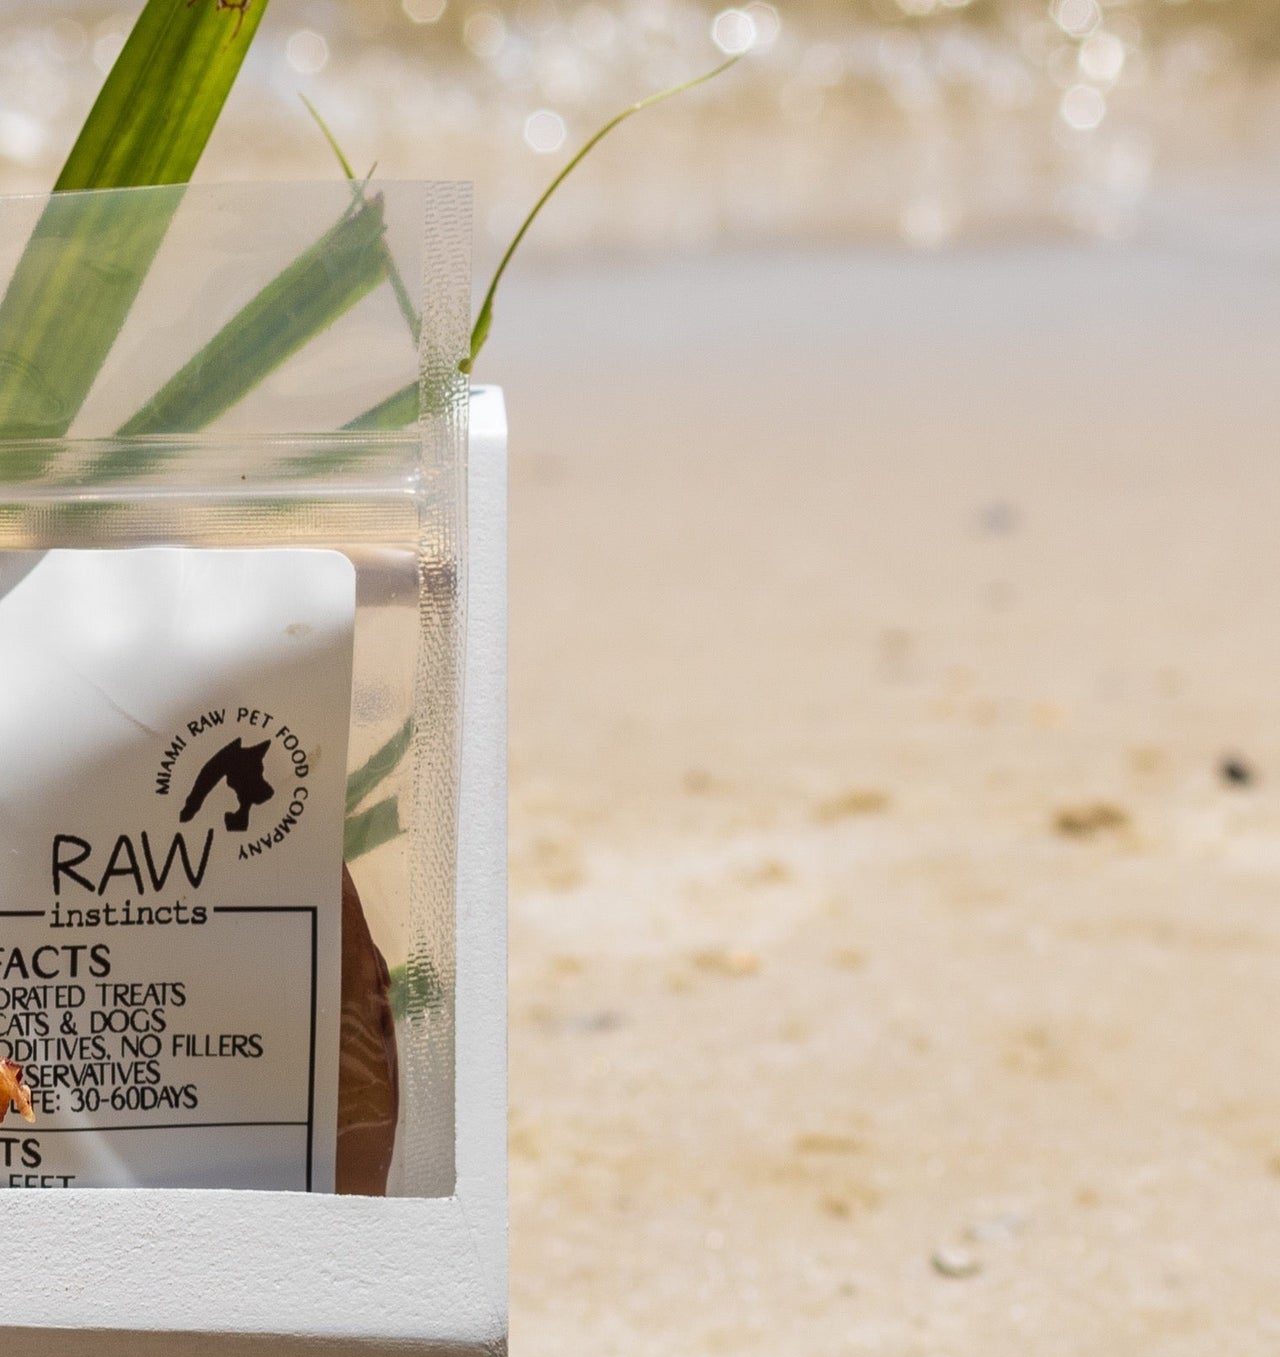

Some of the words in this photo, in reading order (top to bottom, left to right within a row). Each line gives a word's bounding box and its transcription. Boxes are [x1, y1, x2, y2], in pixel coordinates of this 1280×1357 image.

[187, 709, 225, 737] RAW
[237, 707, 274, 729] PET
[156, 735, 187, 795] MIAMI
[275, 726, 309, 778] FOOD
[238, 787, 309, 860] COMPANY
[52, 828, 214, 896] RAW
[50, 900, 208, 928] instincts
[95, 982, 186, 1008] TREATS
[60, 1011, 78, 1035] &
[90, 1008, 166, 1034] DOGS
[121, 1035, 161, 1059] NO
[172, 1034, 263, 1059] FILLERS
[71, 1085, 198, 1114] 30-60DAYS
